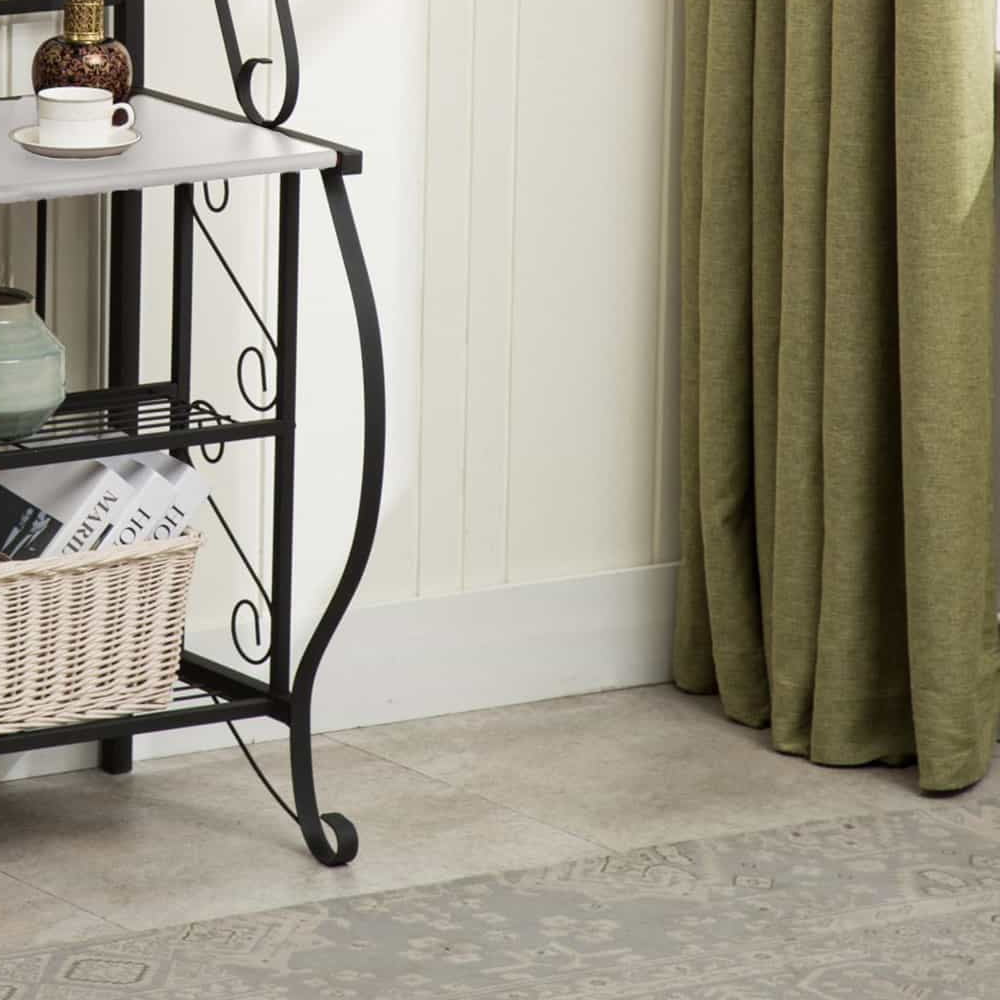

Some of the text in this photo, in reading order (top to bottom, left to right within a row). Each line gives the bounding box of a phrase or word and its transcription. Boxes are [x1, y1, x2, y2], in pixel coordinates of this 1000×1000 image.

[62, 490, 118, 553] MARIL
[113, 508, 151, 545] HO
[153, 505, 185, 540] HO
